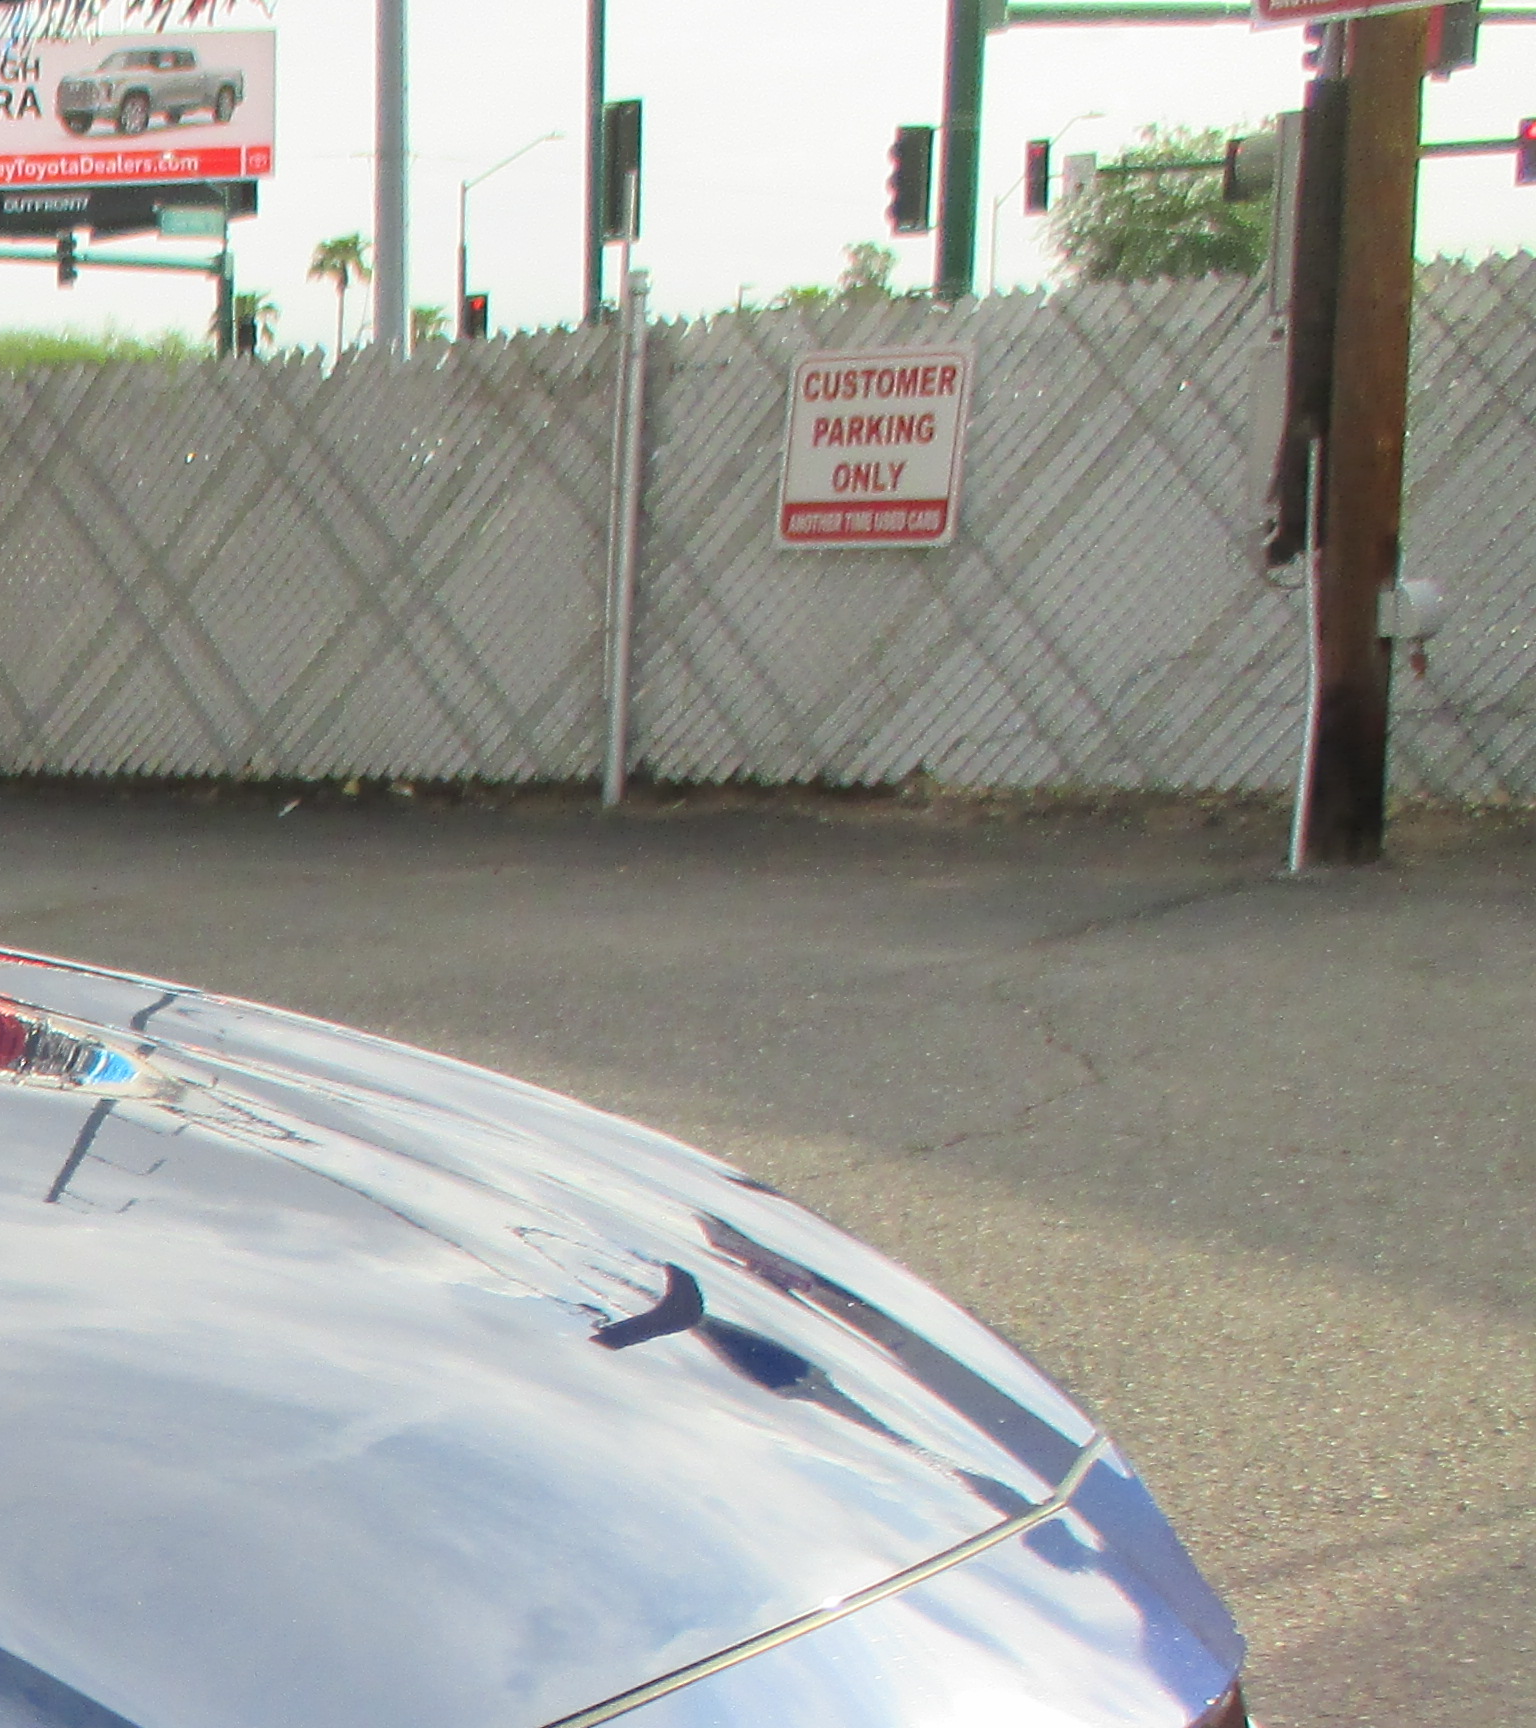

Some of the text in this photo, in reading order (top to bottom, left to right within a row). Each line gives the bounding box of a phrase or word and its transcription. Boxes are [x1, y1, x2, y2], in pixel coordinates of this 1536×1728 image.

[802, 365, 957, 402] CUSTOMER
[812, 413, 935, 447] PARKING
[832, 460, 907, 494] ONLY
